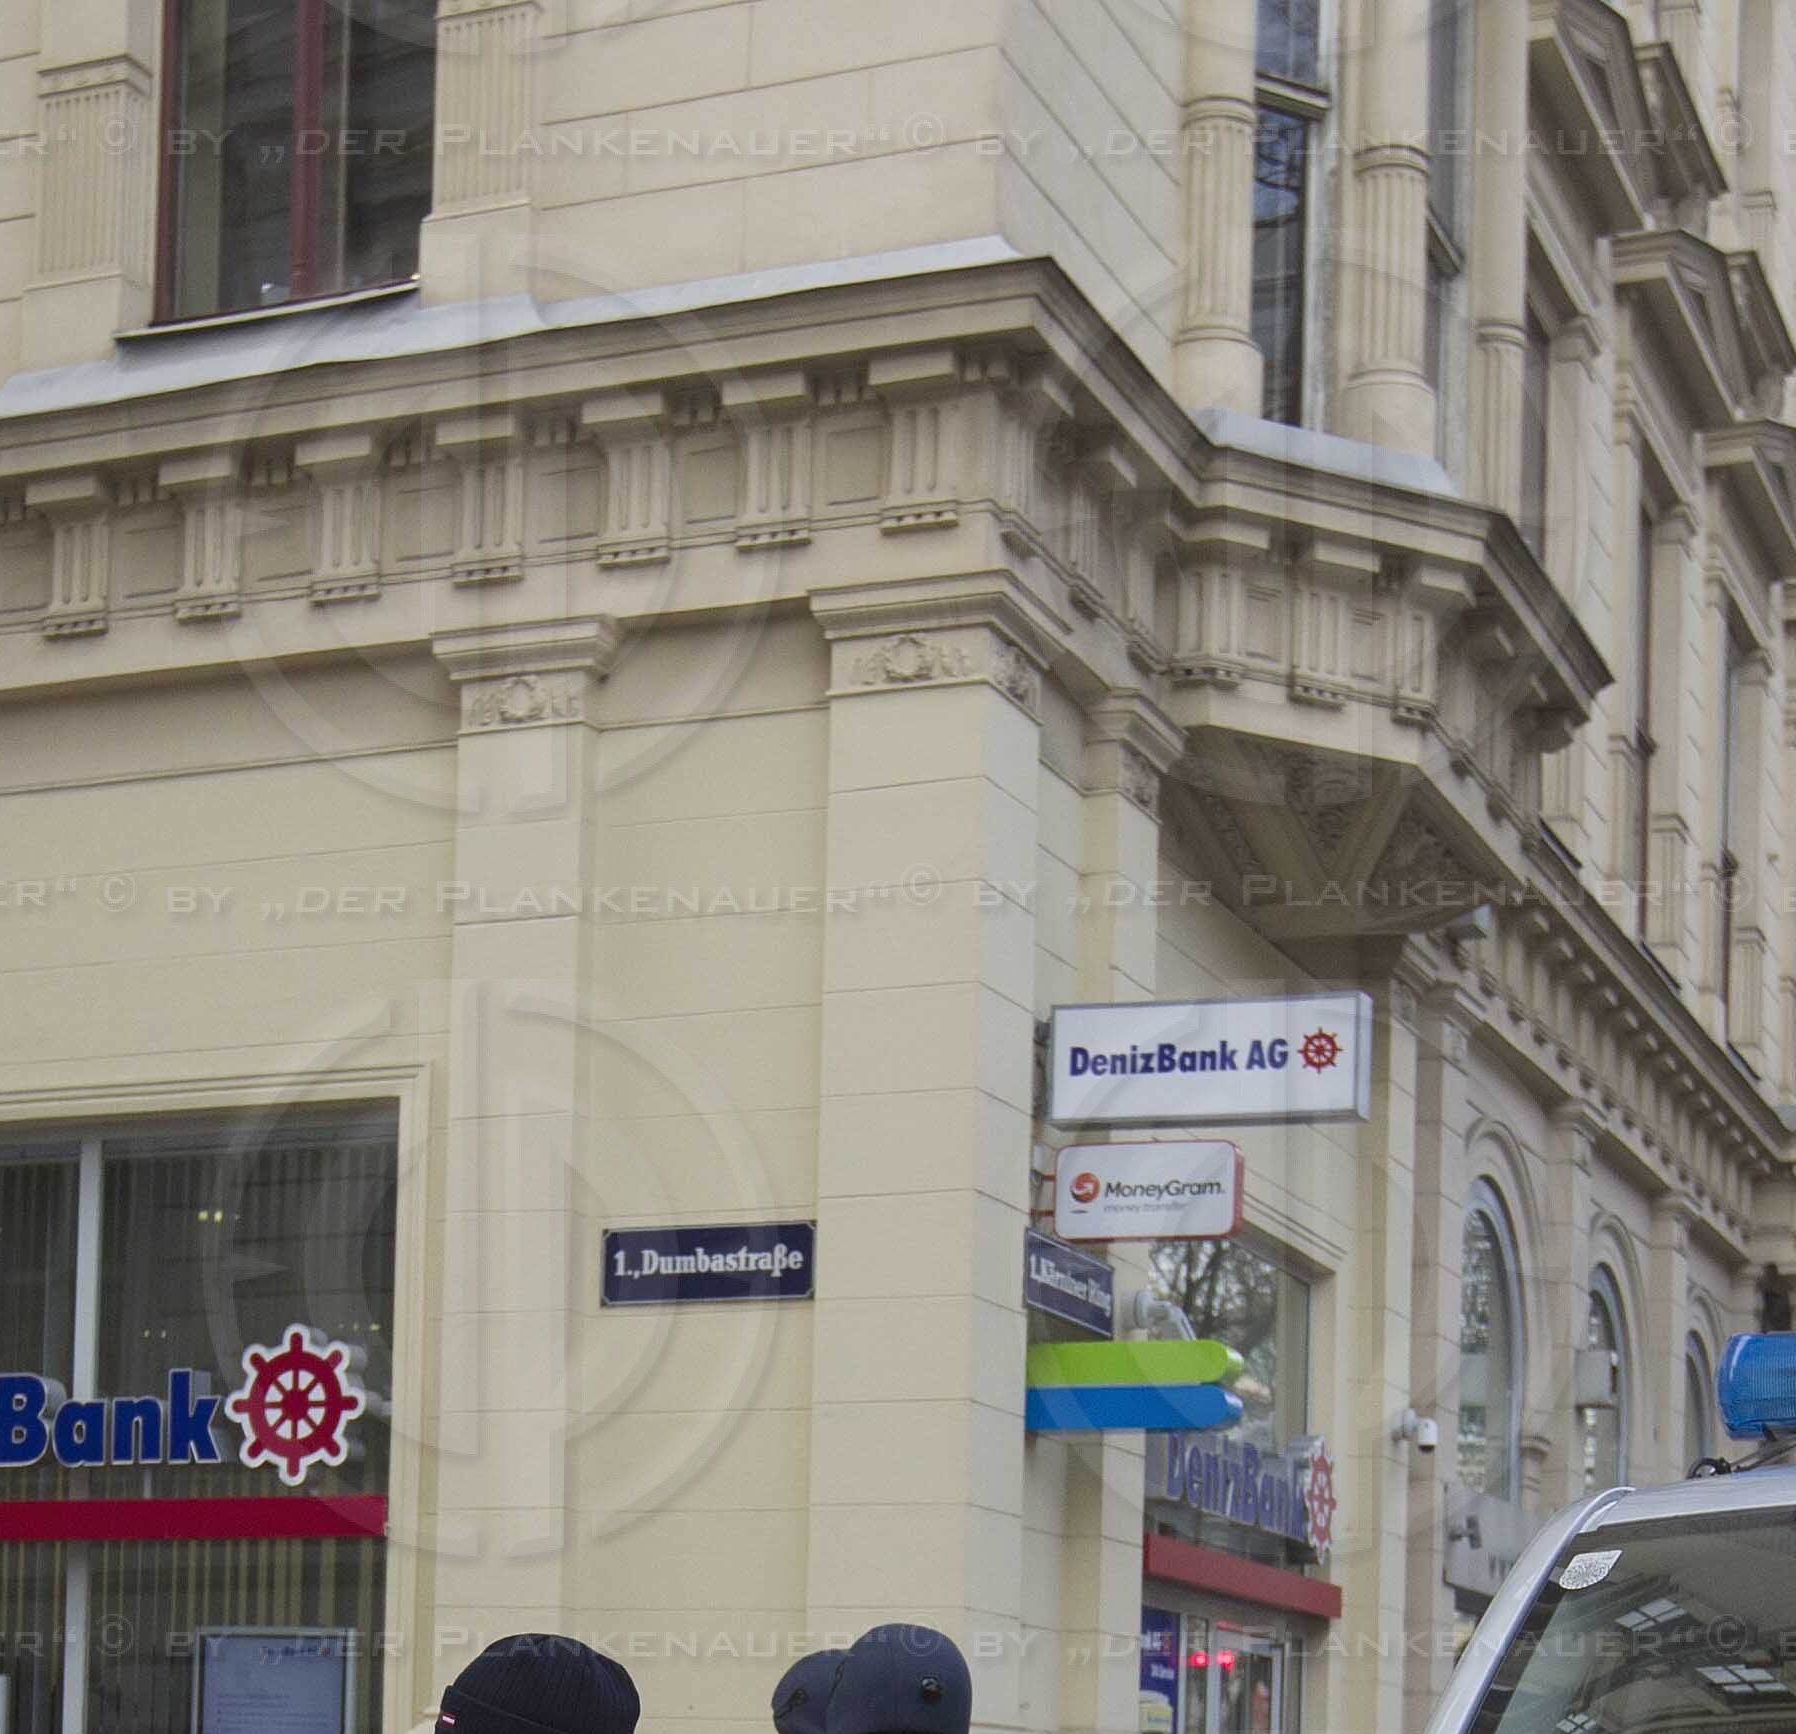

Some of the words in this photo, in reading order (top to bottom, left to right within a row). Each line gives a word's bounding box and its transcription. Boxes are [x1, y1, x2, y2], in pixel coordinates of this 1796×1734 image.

[1069, 1040, 1238, 1077] DenizBank
[1246, 1038, 1290, 1071] AG
[1166, 1432, 1308, 1542] DenizBank
